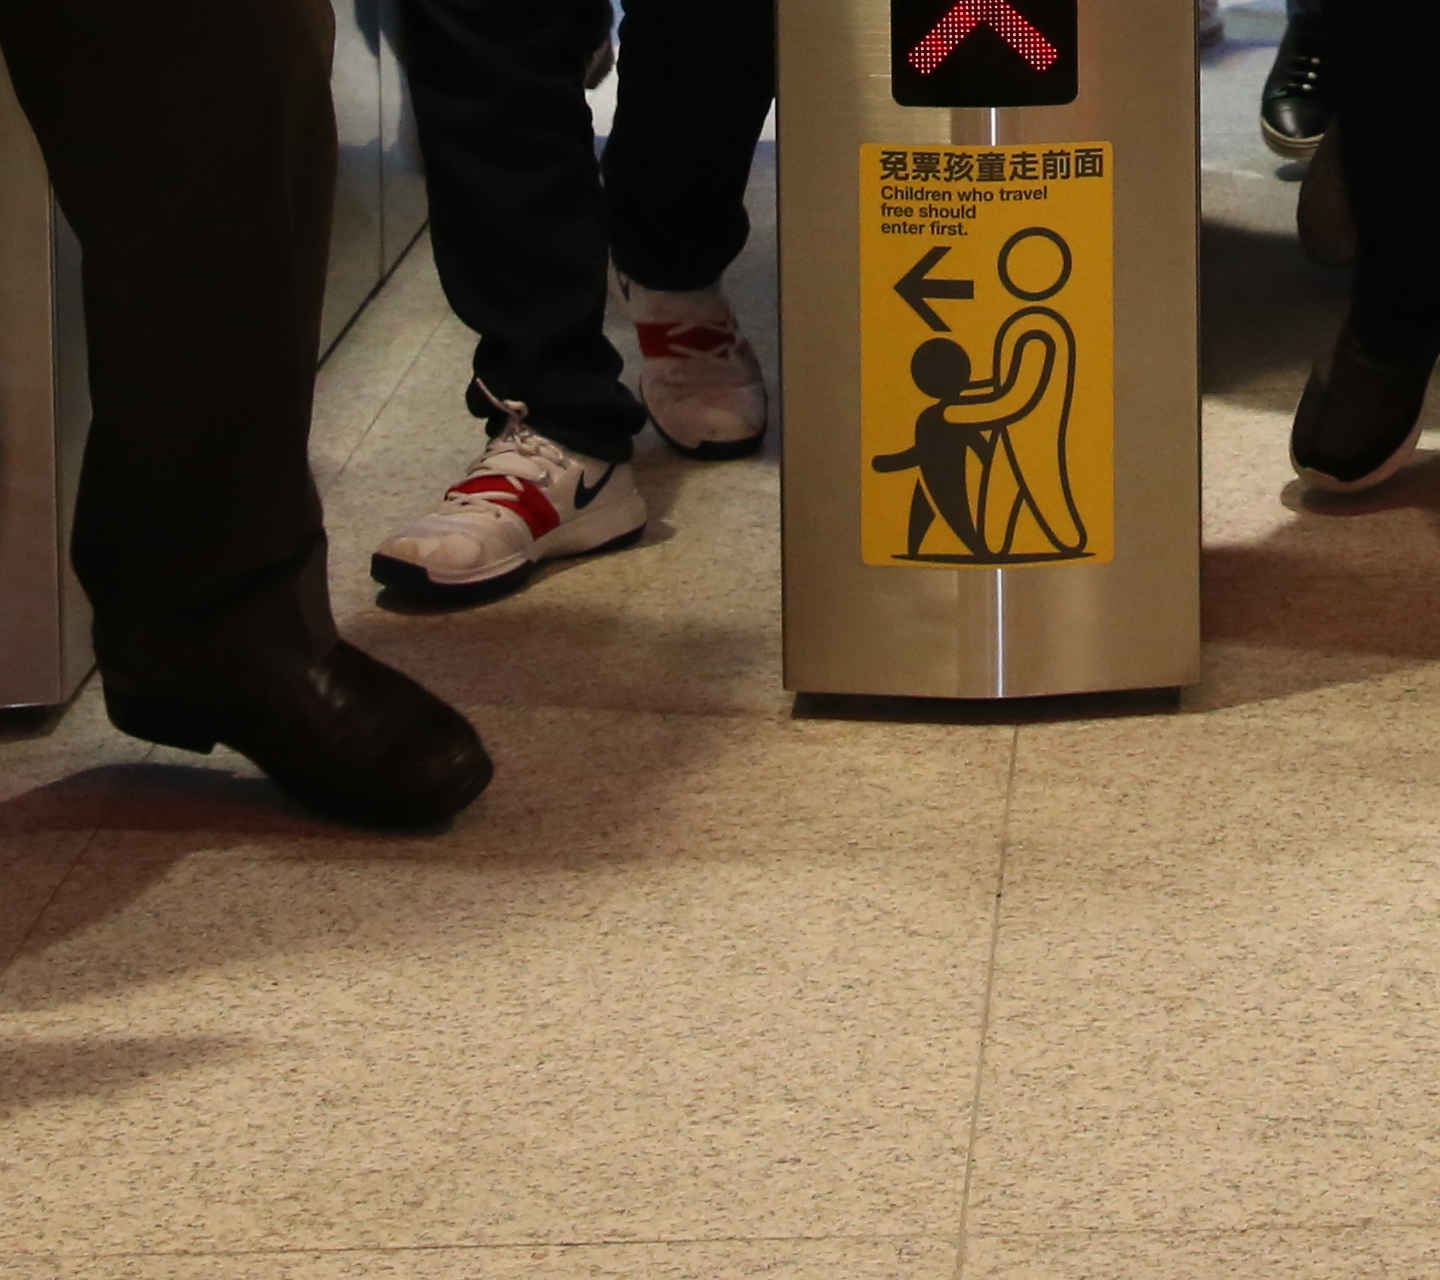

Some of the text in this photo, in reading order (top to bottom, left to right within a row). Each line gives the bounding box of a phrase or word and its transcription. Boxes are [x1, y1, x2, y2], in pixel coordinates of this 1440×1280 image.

[879, 147, 1104, 182] 免票孩童走前面
[881, 185, 1048, 202] Children who travel
[880, 202, 977, 219] free should
[881, 220, 968, 237] enter first.
